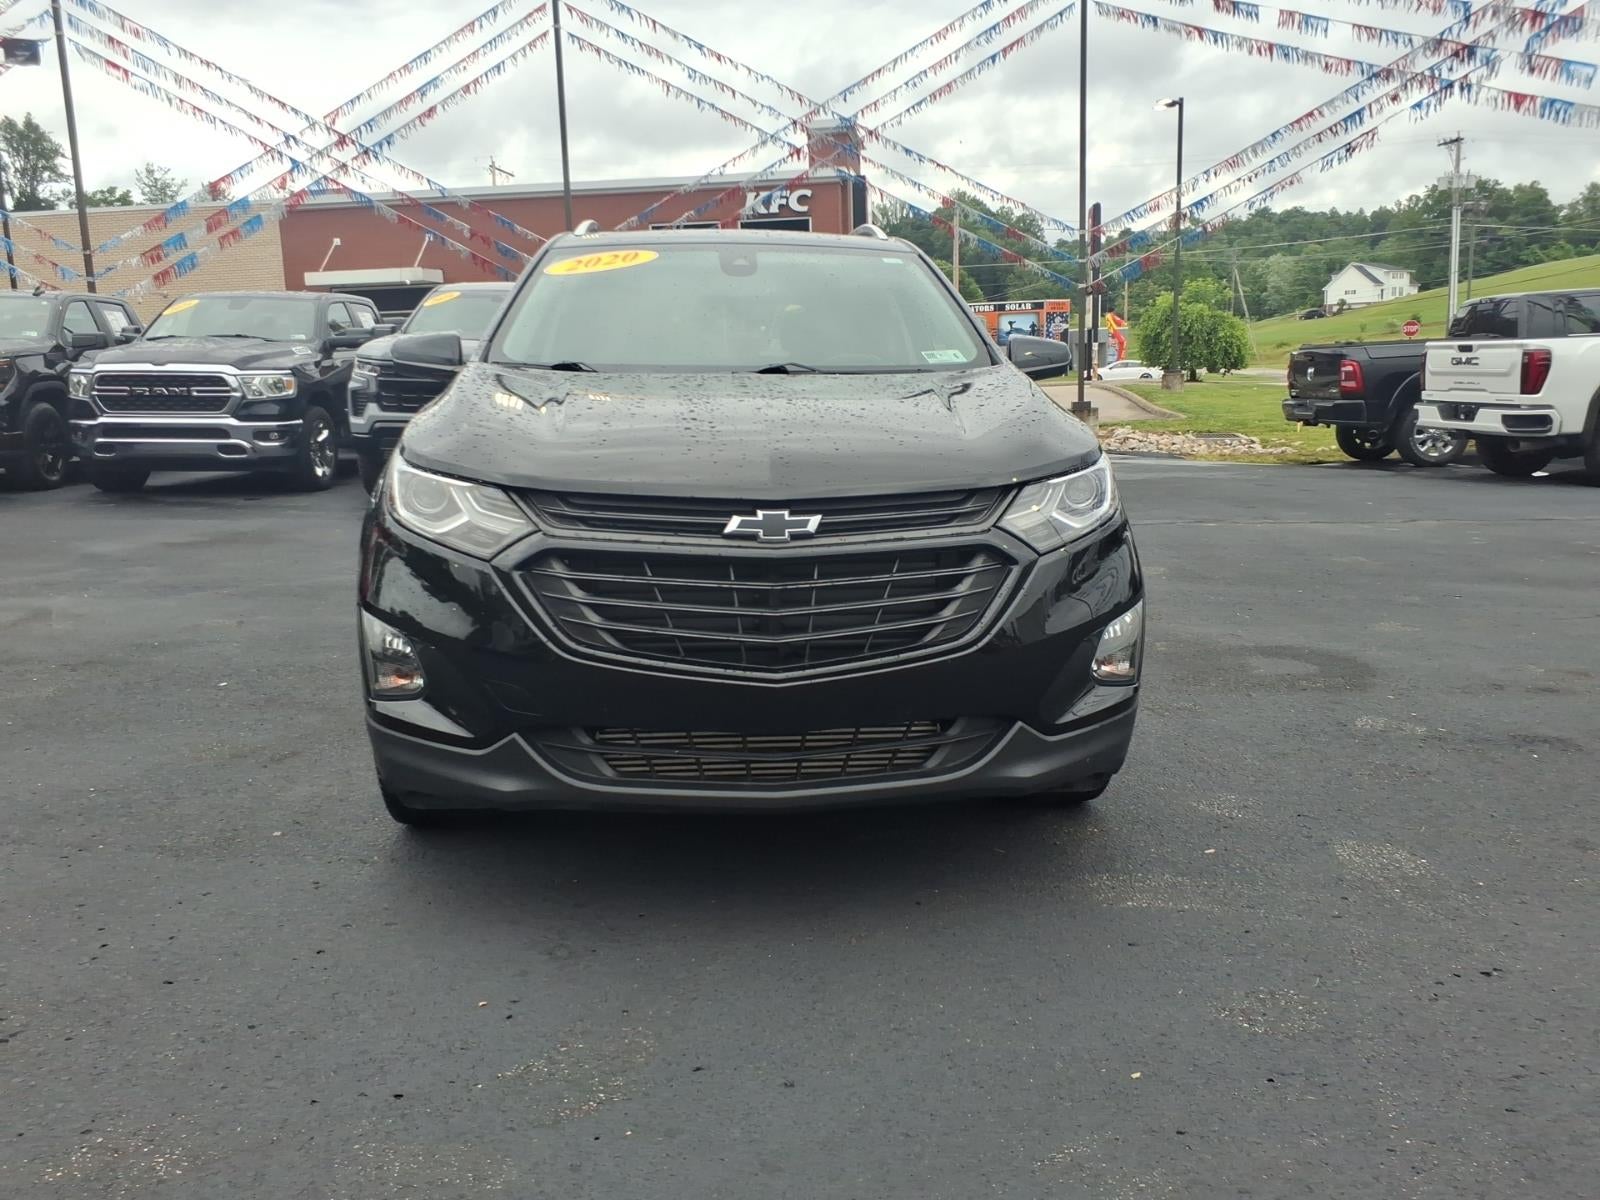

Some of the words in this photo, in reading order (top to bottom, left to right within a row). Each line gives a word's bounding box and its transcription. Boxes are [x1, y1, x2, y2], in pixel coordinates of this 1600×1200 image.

[745, 189, 812, 214] KFC
[564, 252, 640, 272] 2020
[1005, 302, 1031, 310] SOLAR
[1451, 357, 1480, 365] GMC
[131, 386, 190, 396] RAM
